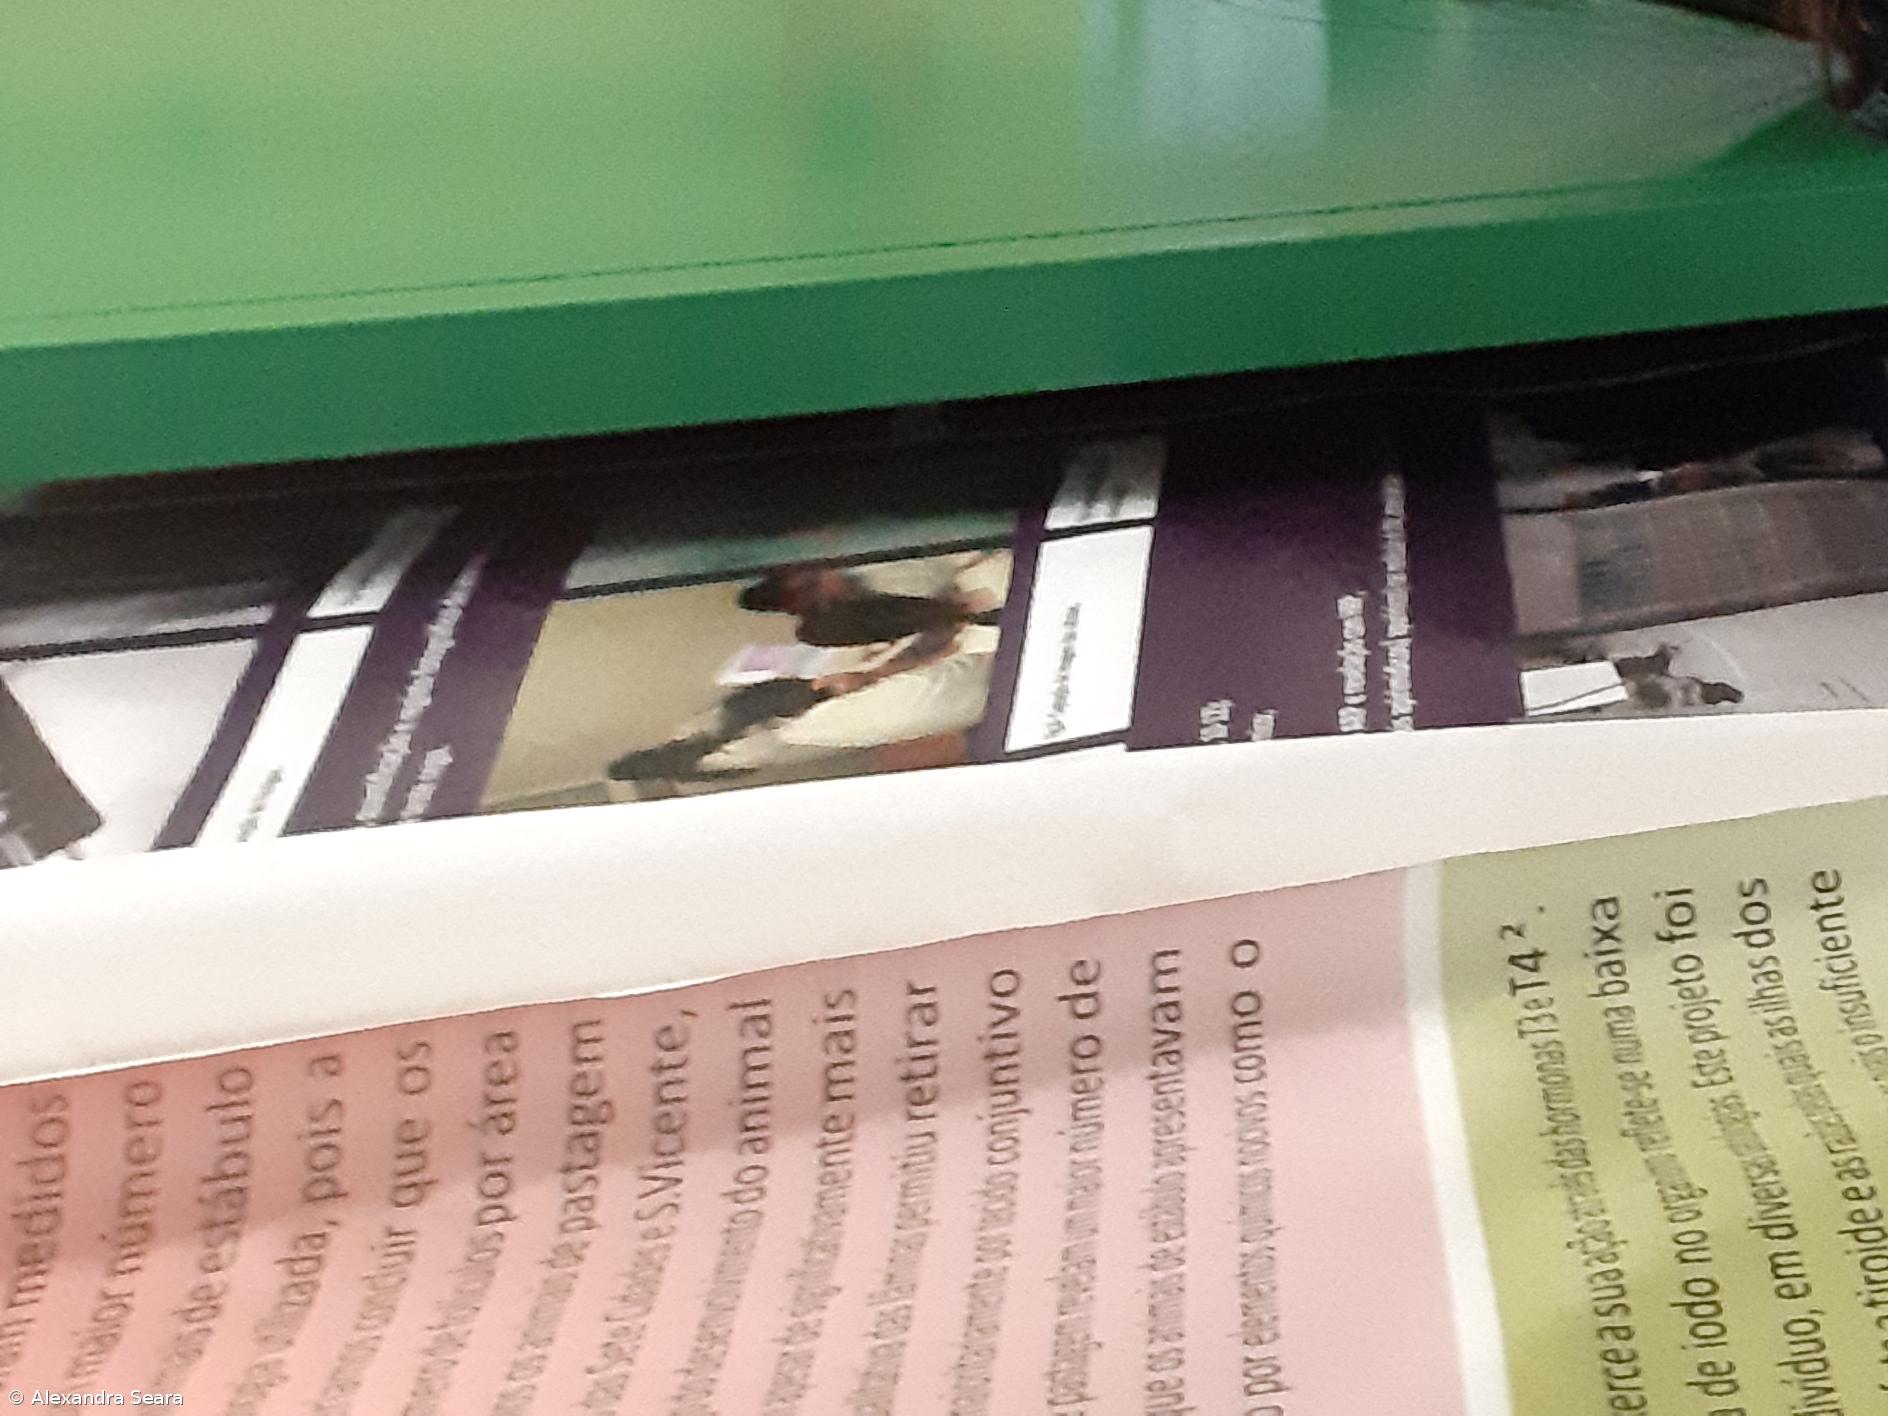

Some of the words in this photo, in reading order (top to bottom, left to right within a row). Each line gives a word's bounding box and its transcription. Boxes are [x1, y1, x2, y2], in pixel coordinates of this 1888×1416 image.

[1583, 894, 1631, 999] baixa
[1652, 886, 1699, 945] foi
[1730, 875, 1776, 949] dos
[1229, 938, 1261, 969] o
[1746, 954, 1793, 1013] ilhas
[1806, 868, 1877, 1032] insuficiente
[1056, 959, 1102, 1020] de
[1667, 953, 1730, 1044] projeto
[306, 1053, 342, 1077] a
[397, 1041, 432, 1096] os
[812, 988, 858, 1102] mais
[895, 981, 940, 1121] retirar
[977, 968, 1030, 1167] conjuntivo
[1143, 948, 1198, 1170] apresentavam
[1229, 989, 1268, 1085] como
[1602, 1004, 1646, 1064] numa
[1687, 1048, 1735, 1089] Este
[465, 1030, 519, 1136] área
[727, 998, 774, 1155] animal
[298, 1098, 350, 1204] pois
[556, 1018, 614, 1233] pastagem
[99, 1080, 162, 1278] número
[197, 1067, 253, 1274] estábulo
[388, 1118, 440, 1209] que
[474, 1152, 521, 1228] por
[718, 1164, 770, 1205] do
[1840, 1186, 1877, 1202] e
[1670, 1229, 1712, 1265] no
[1767, 1250, 1813, 1300] em
[1588, 1267, 1632, 1318] sua
[1668, 1277, 1729, 1351] iodo
[1596, 1325, 1635, 1342] a
[1240, 1355, 1295, 1397] por
[1684, 1360, 1740, 1397] de
